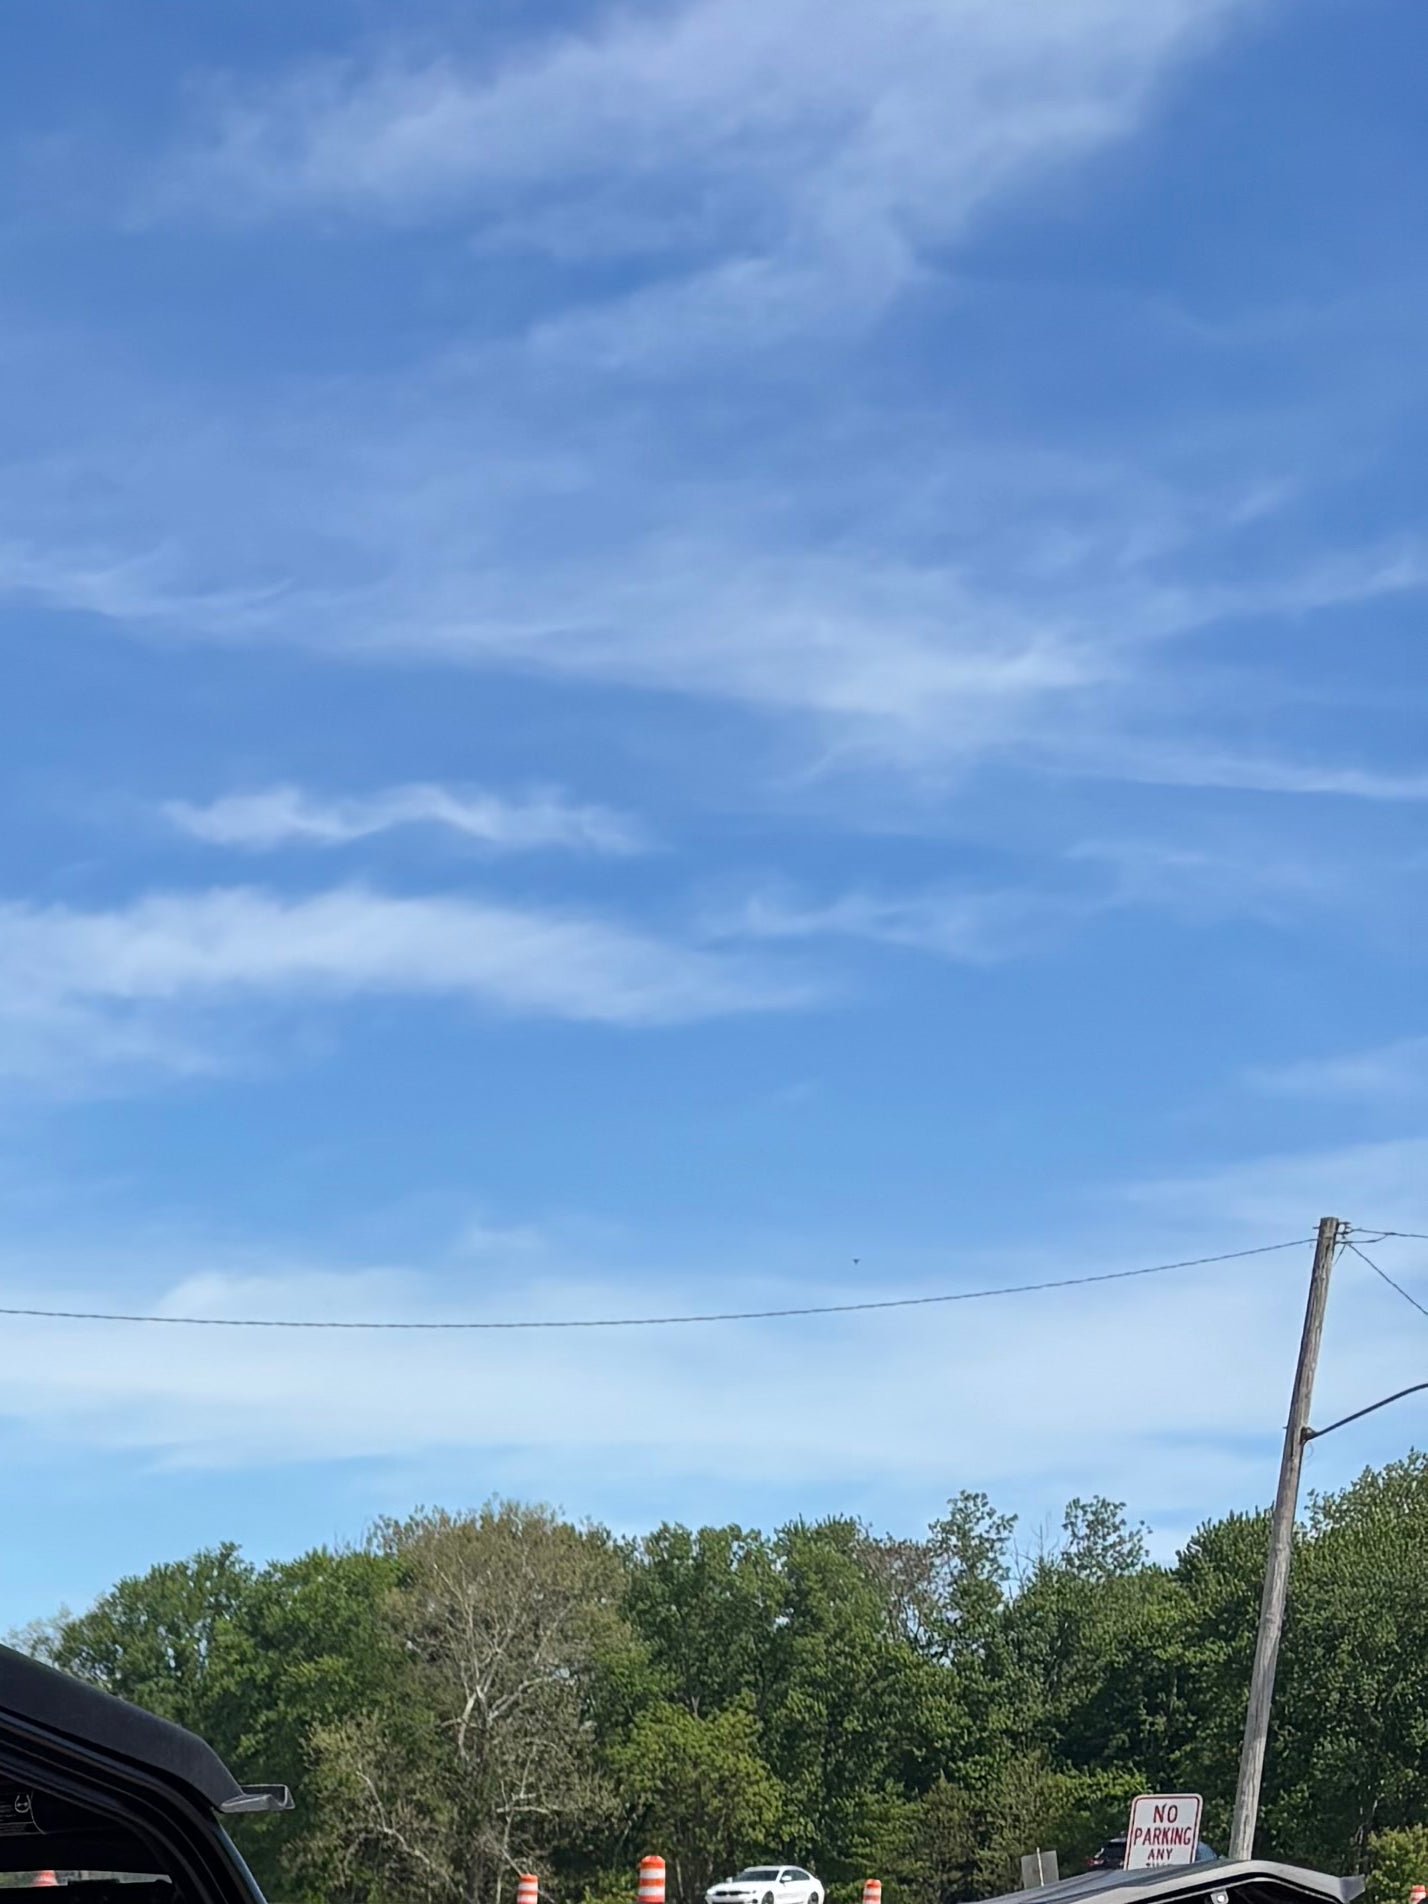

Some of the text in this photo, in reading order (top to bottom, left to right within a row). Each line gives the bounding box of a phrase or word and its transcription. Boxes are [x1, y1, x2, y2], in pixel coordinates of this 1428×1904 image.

[1153, 1804, 1178, 1823] NO
[1133, 1827, 1192, 1845] PARKING
[1147, 1848, 1173, 1860] ANY
